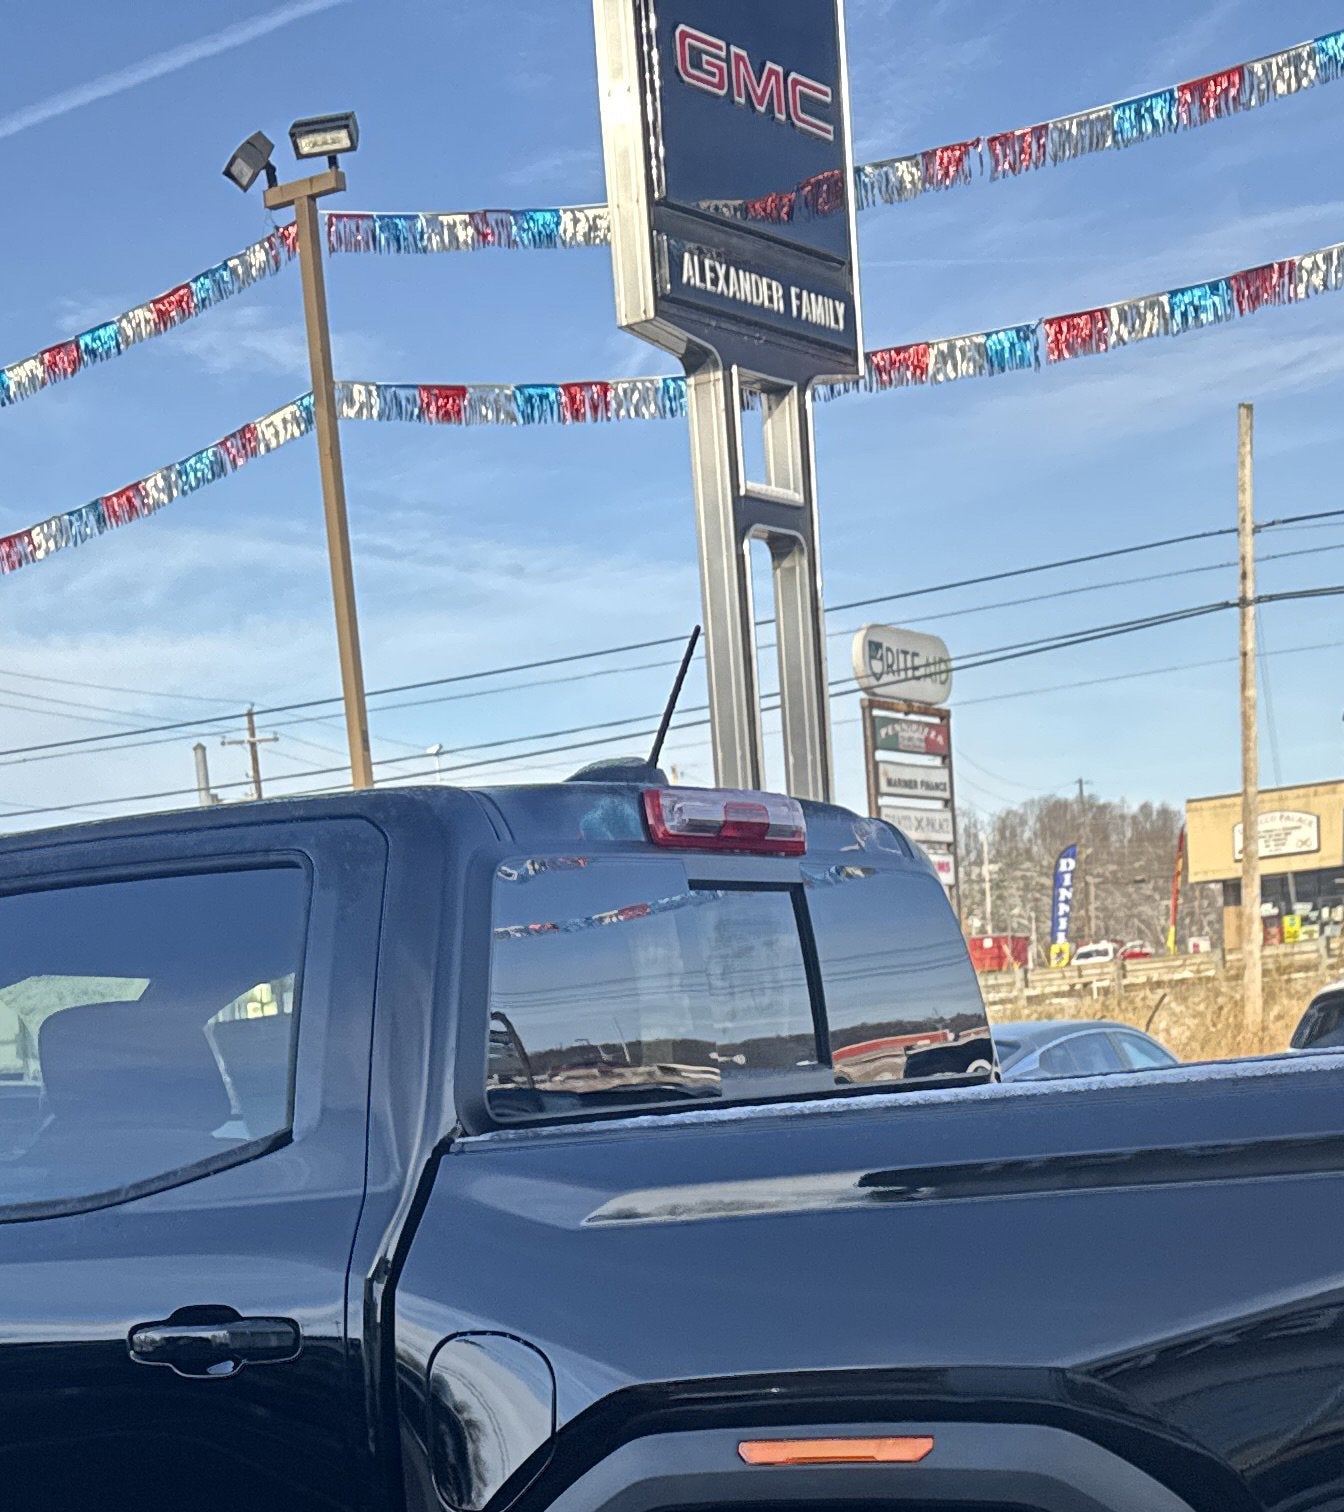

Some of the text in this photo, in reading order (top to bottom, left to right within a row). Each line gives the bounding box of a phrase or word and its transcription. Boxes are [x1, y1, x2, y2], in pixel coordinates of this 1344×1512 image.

[675, 23, 834, 142] GMC
[682, 251, 845, 332] ALEXANDER FAMILY
[885, 645, 920, 681] RITE
